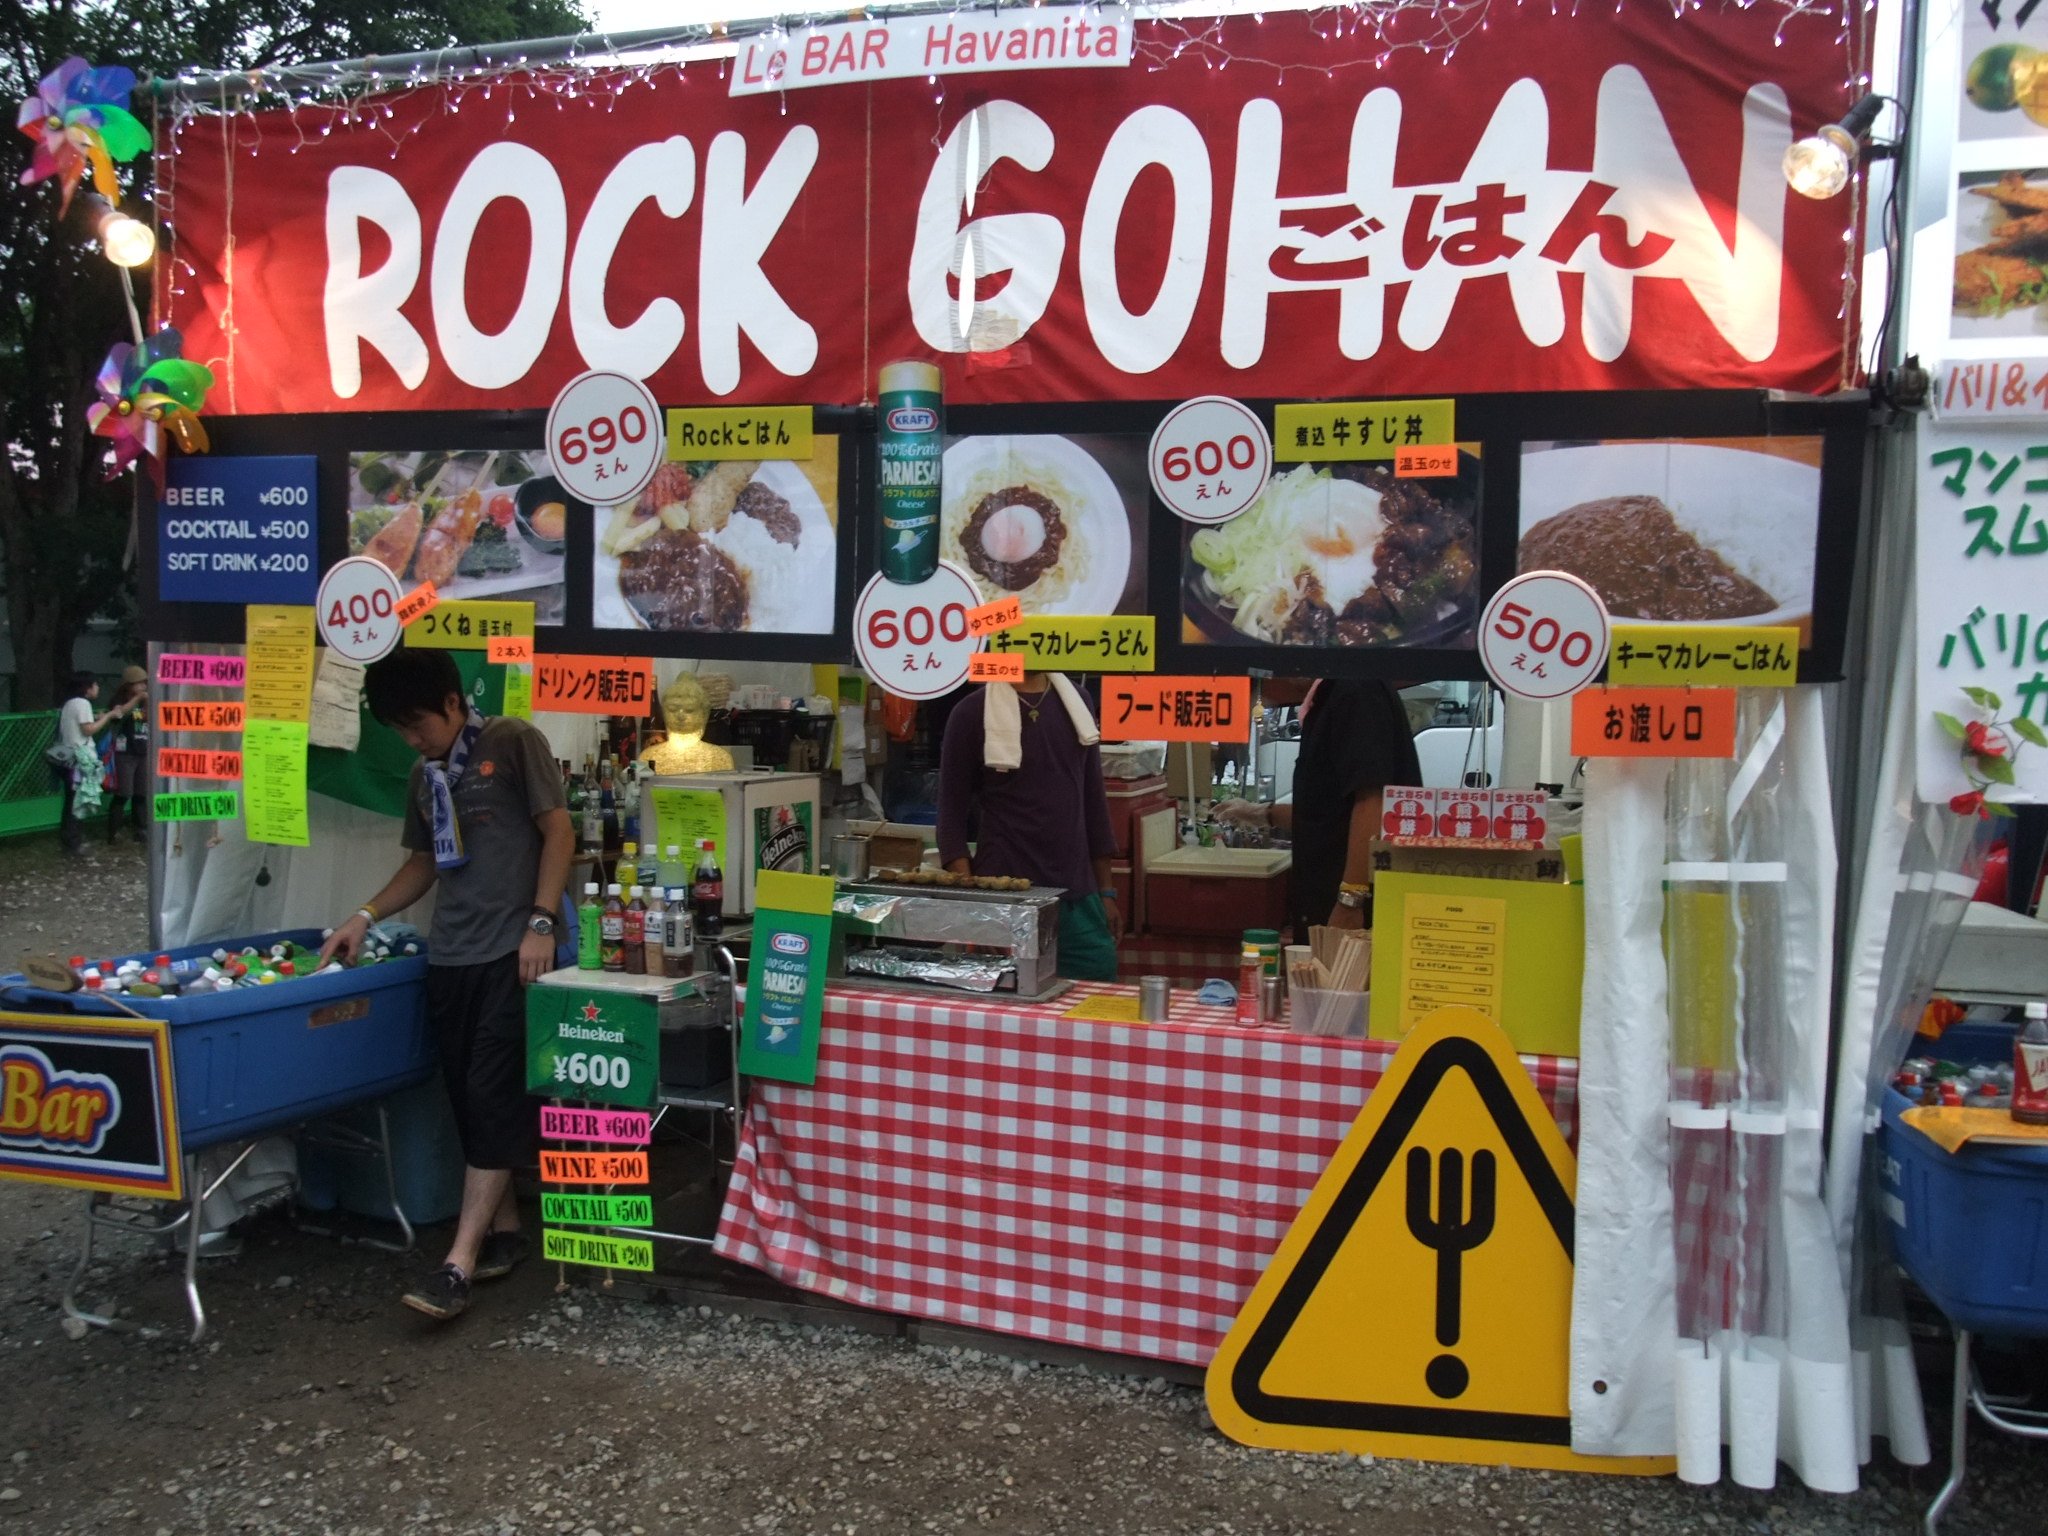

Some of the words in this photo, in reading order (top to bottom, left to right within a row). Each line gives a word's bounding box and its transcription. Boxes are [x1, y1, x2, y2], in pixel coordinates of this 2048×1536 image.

[744, 44, 787, 84] Le
[801, 28, 889, 76] BAR
[924, 15, 1119, 67] Havanita
[324, 124, 820, 399] ROCK
[907, 62, 1794, 375] GOHAN
[1266, 178, 1677, 283] ごはん
[894, 414, 931, 426] KRAFT
[558, 405, 648, 466] 690
[682, 419, 791, 447] Rockごはん
[594, 458, 628, 482] えん
[1161, 434, 1256, 482] 600
[1400, 456, 1452, 472] 温玉のせ
[166, 487, 225, 506] BEER
[259, 487, 309, 506] ¥600
[1196, 481, 1232, 500] えん
[896, 499, 926, 509] Cheese
[167, 520, 257, 539] COCKTAIL
[261, 520, 310, 539] ¥500
[168, 553, 209, 571] SOFT
[212, 553, 257, 571] DRINK
[260, 554, 309, 572] ¥200
[327, 587, 393, 628] 400
[970, 608, 1020, 631] ゆであげ
[352, 630, 378, 645] えん
[867, 602, 968, 650] 600
[1494, 601, 1593, 668] 500
[497, 646, 526, 658] 2本入
[996, 627, 1149, 657] キーマカレーうどん
[902, 651, 942, 672] えん
[1510, 652, 1548, 679] えん
[1616, 640, 1791, 672] キーマカレーごはん
[160, 659, 205, 680] BEER
[972, 662, 1020, 676] 温玉のせ
[537, 668, 646, 703] ドリンク販売口
[162, 706, 205, 726] WINE
[1116, 690, 1233, 727] フード販売口
[1603, 704, 1704, 743] お渡し口
[160, 752, 207, 774] COCKTAIL
[180, 796, 212, 816] DRINK
[778, 938, 803, 949] KRAFT
[558, 1022, 625, 1044] Heineken
[553, 1052, 631, 1089] ¥600
[0, 1064, 102, 1137] Bar
[545, 1111, 600, 1136] BEER
[605, 1116, 646, 1139] ¥600
[545, 1156, 597, 1179] WINE
[602, 1156, 643, 1179] ¥500
[545, 1197, 613, 1221] COCKTAIL
[615, 1200, 648, 1222] ¥500
[547, 1234, 577, 1259] SOFT
[579, 1238, 619, 1264] DRINK
[622, 1244, 650, 1268] ¥200
